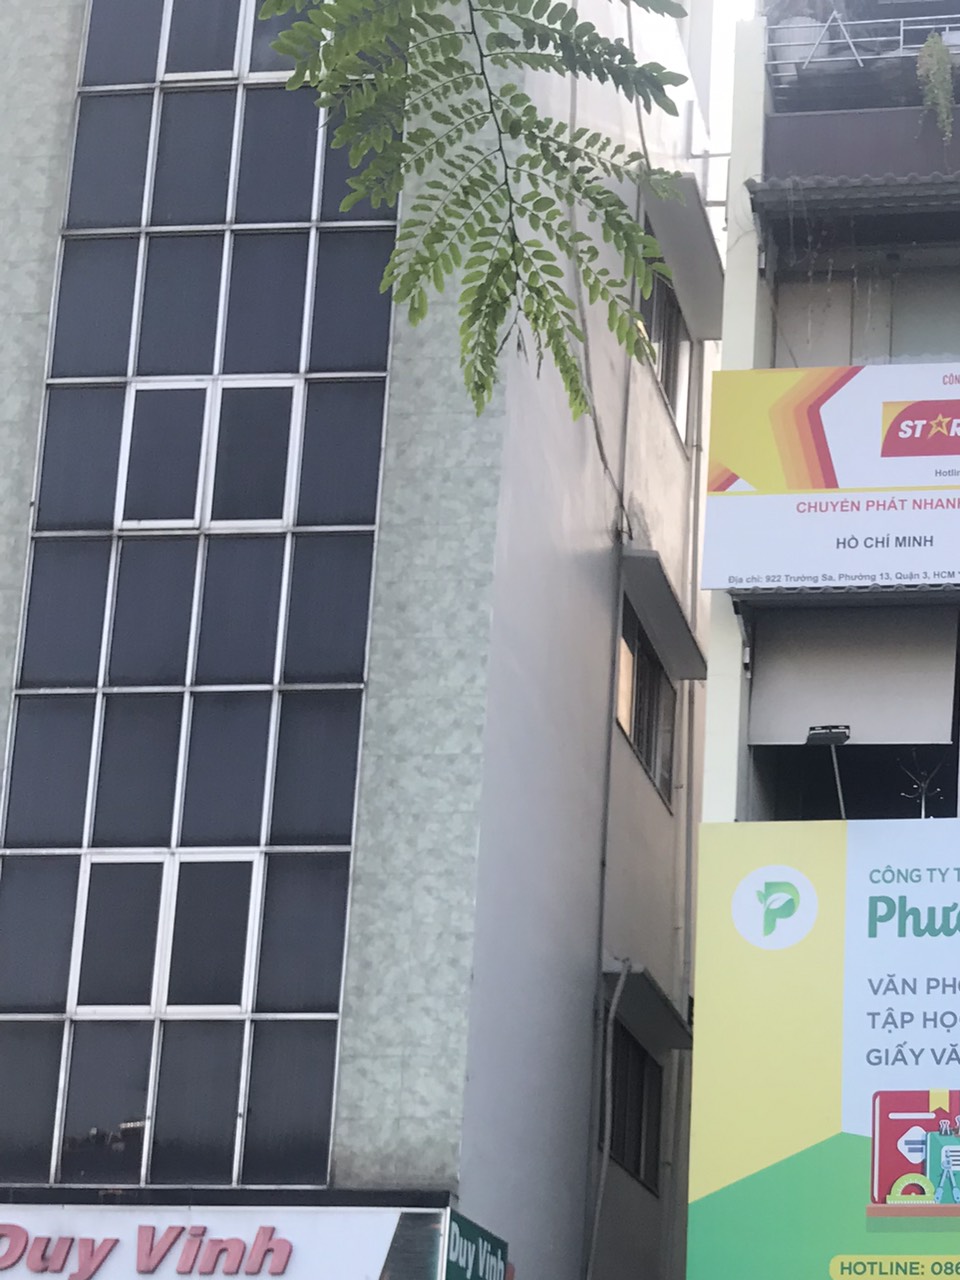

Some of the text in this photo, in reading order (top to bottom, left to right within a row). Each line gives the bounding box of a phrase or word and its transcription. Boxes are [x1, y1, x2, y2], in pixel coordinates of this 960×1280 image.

[865, 496, 907, 512] PHÁT
[863, 533, 890, 549] CHÍ
[895, 535, 934, 548] MINH
[728, 575, 743, 585] Địa
[765, 575, 782, 583] 922
[784, 573, 819, 585] Trường
[838, 572, 876, 583] Phường
[895, 571, 919, 582] Quận
[933, 571, 955, 579] HCM
[869, 866, 922, 884] CÔNG
[926, 867, 949, 883] TY
[867, 973, 918, 996] VĂN
[866, 1008, 915, 1034] TẬP
[865, 1041, 925, 1067] GIẤY
[136, 1225, 294, 1277] Vinh
[449, 1220, 476, 1280] Duy
[840, 1261, 925, 1278] HOTLINE:
